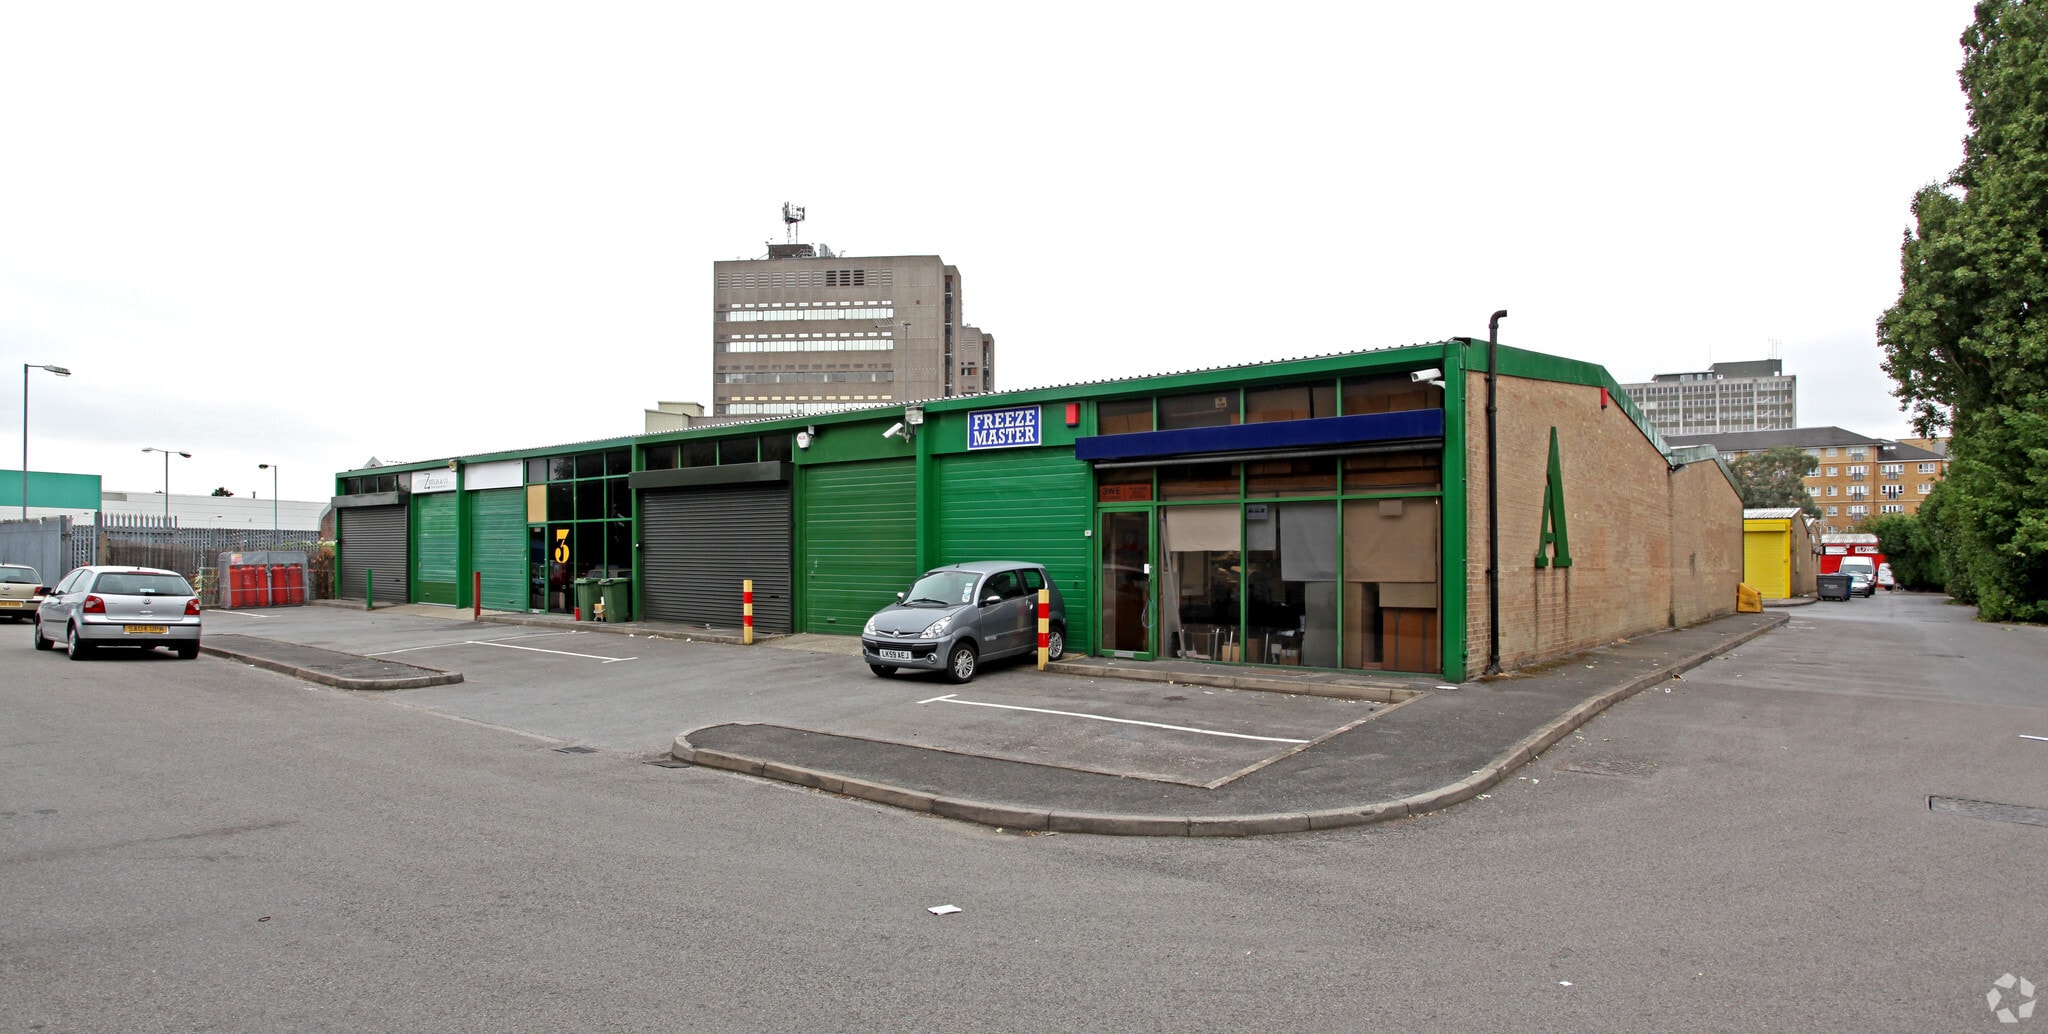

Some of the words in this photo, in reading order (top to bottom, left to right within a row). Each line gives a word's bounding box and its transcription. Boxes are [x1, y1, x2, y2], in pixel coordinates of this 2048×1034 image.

[973, 409, 1035, 430] FREEZE
[973, 426, 1035, 446] MASTER
[1535, 426, 1573, 568] A
[555, 529, 570, 564] 3
[881, 650, 897, 659] LK59
[897, 651, 909, 660] AEJ
